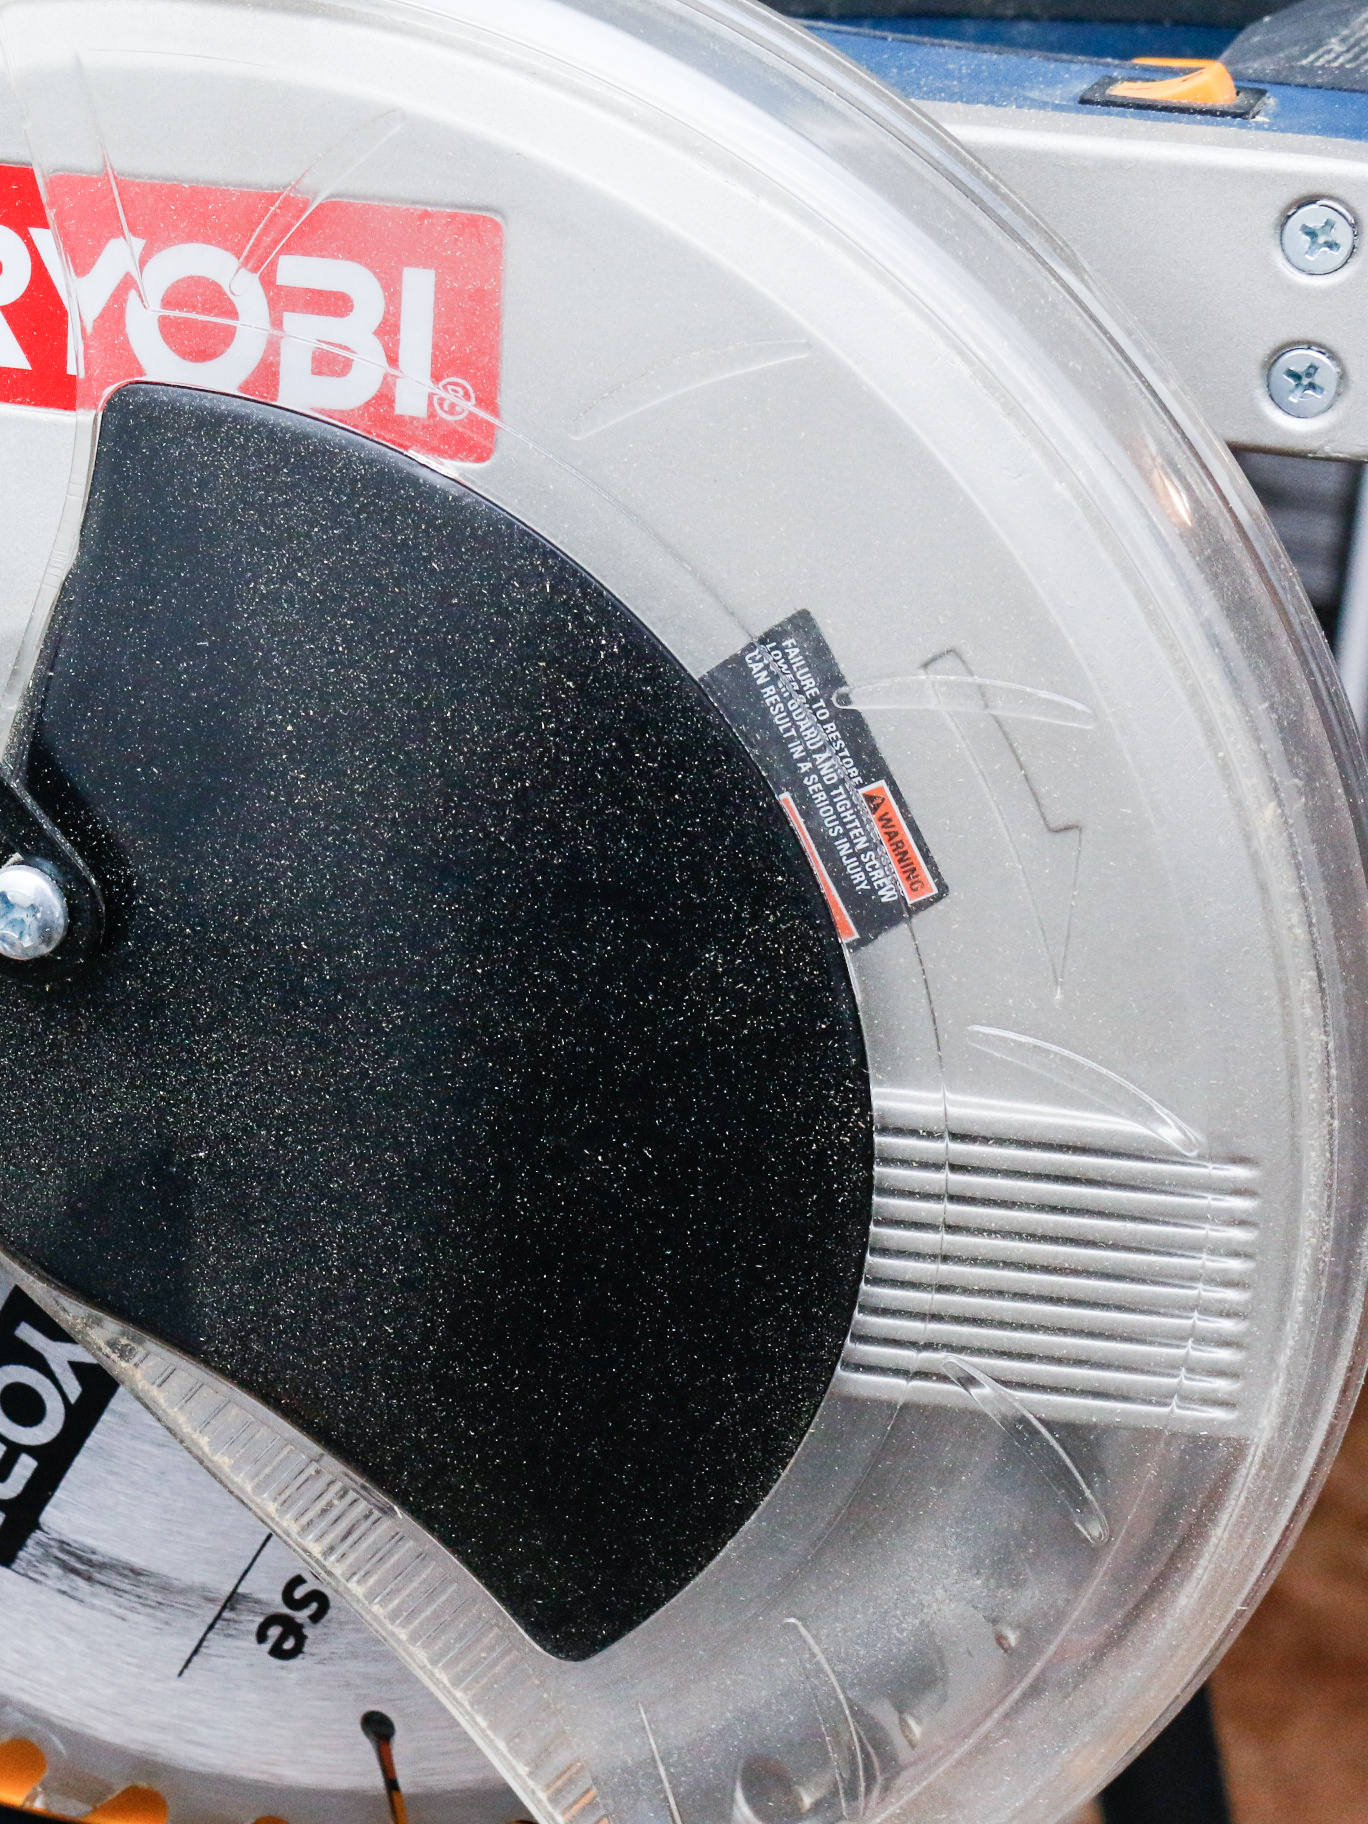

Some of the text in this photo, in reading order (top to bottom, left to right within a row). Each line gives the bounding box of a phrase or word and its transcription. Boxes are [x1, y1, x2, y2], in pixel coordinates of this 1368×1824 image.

[744, 649, 771, 685] CAN
[760, 684, 797, 740] RESULT
[781, 637, 863, 786] FAILURE TO RESTORE
[787, 740, 806, 760] IN
[797, 758, 813, 773] A
[802, 773, 842, 838] SERIOUS
[812, 748, 841, 786] AND
[829, 786, 870, 850] TIGHTEN
[860, 849, 900, 904] SCREW
[878, 811, 925, 893] WARNING
